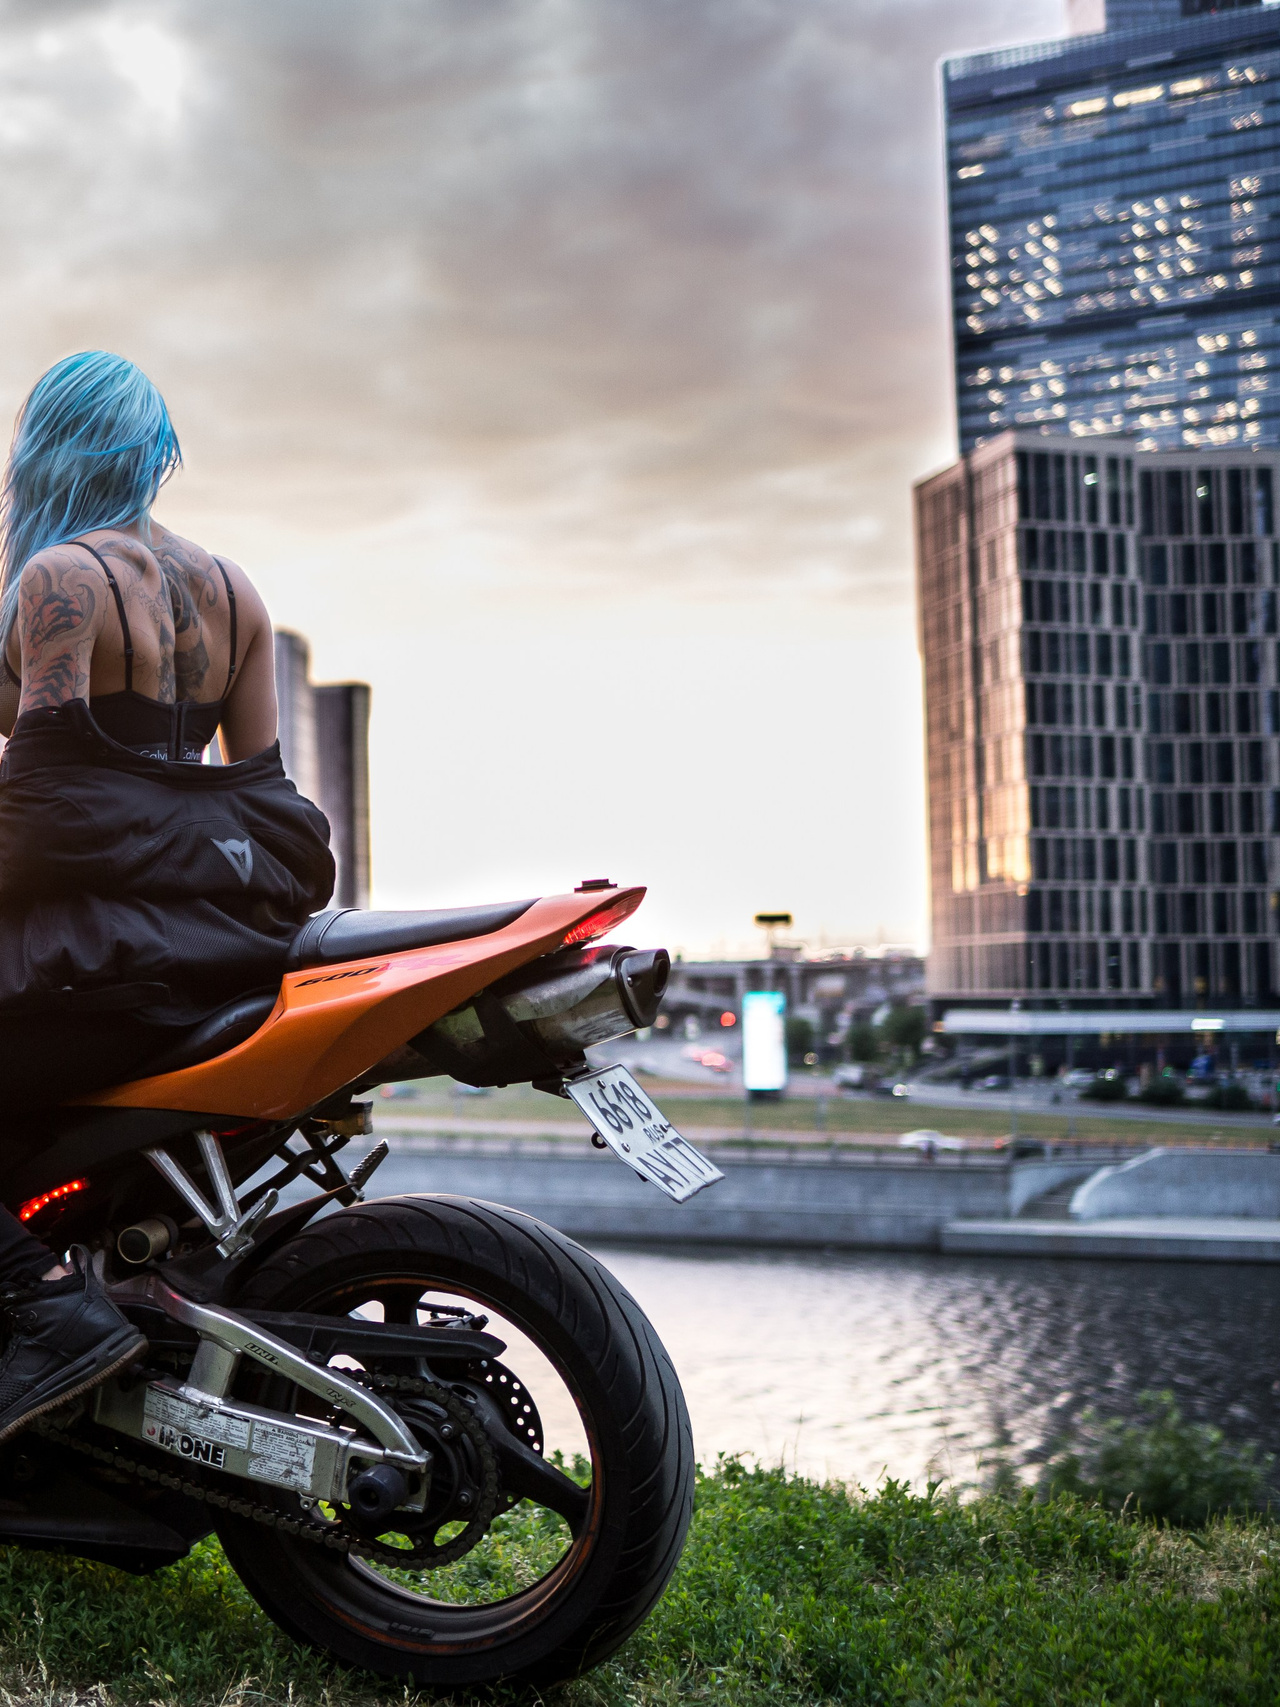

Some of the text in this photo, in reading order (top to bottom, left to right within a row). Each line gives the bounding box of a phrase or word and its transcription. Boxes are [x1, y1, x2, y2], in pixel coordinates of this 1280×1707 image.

[140, 749, 168, 761] Calvi
[588, 1080, 653, 1135] 6618
[642, 1123, 665, 1145] RUS
